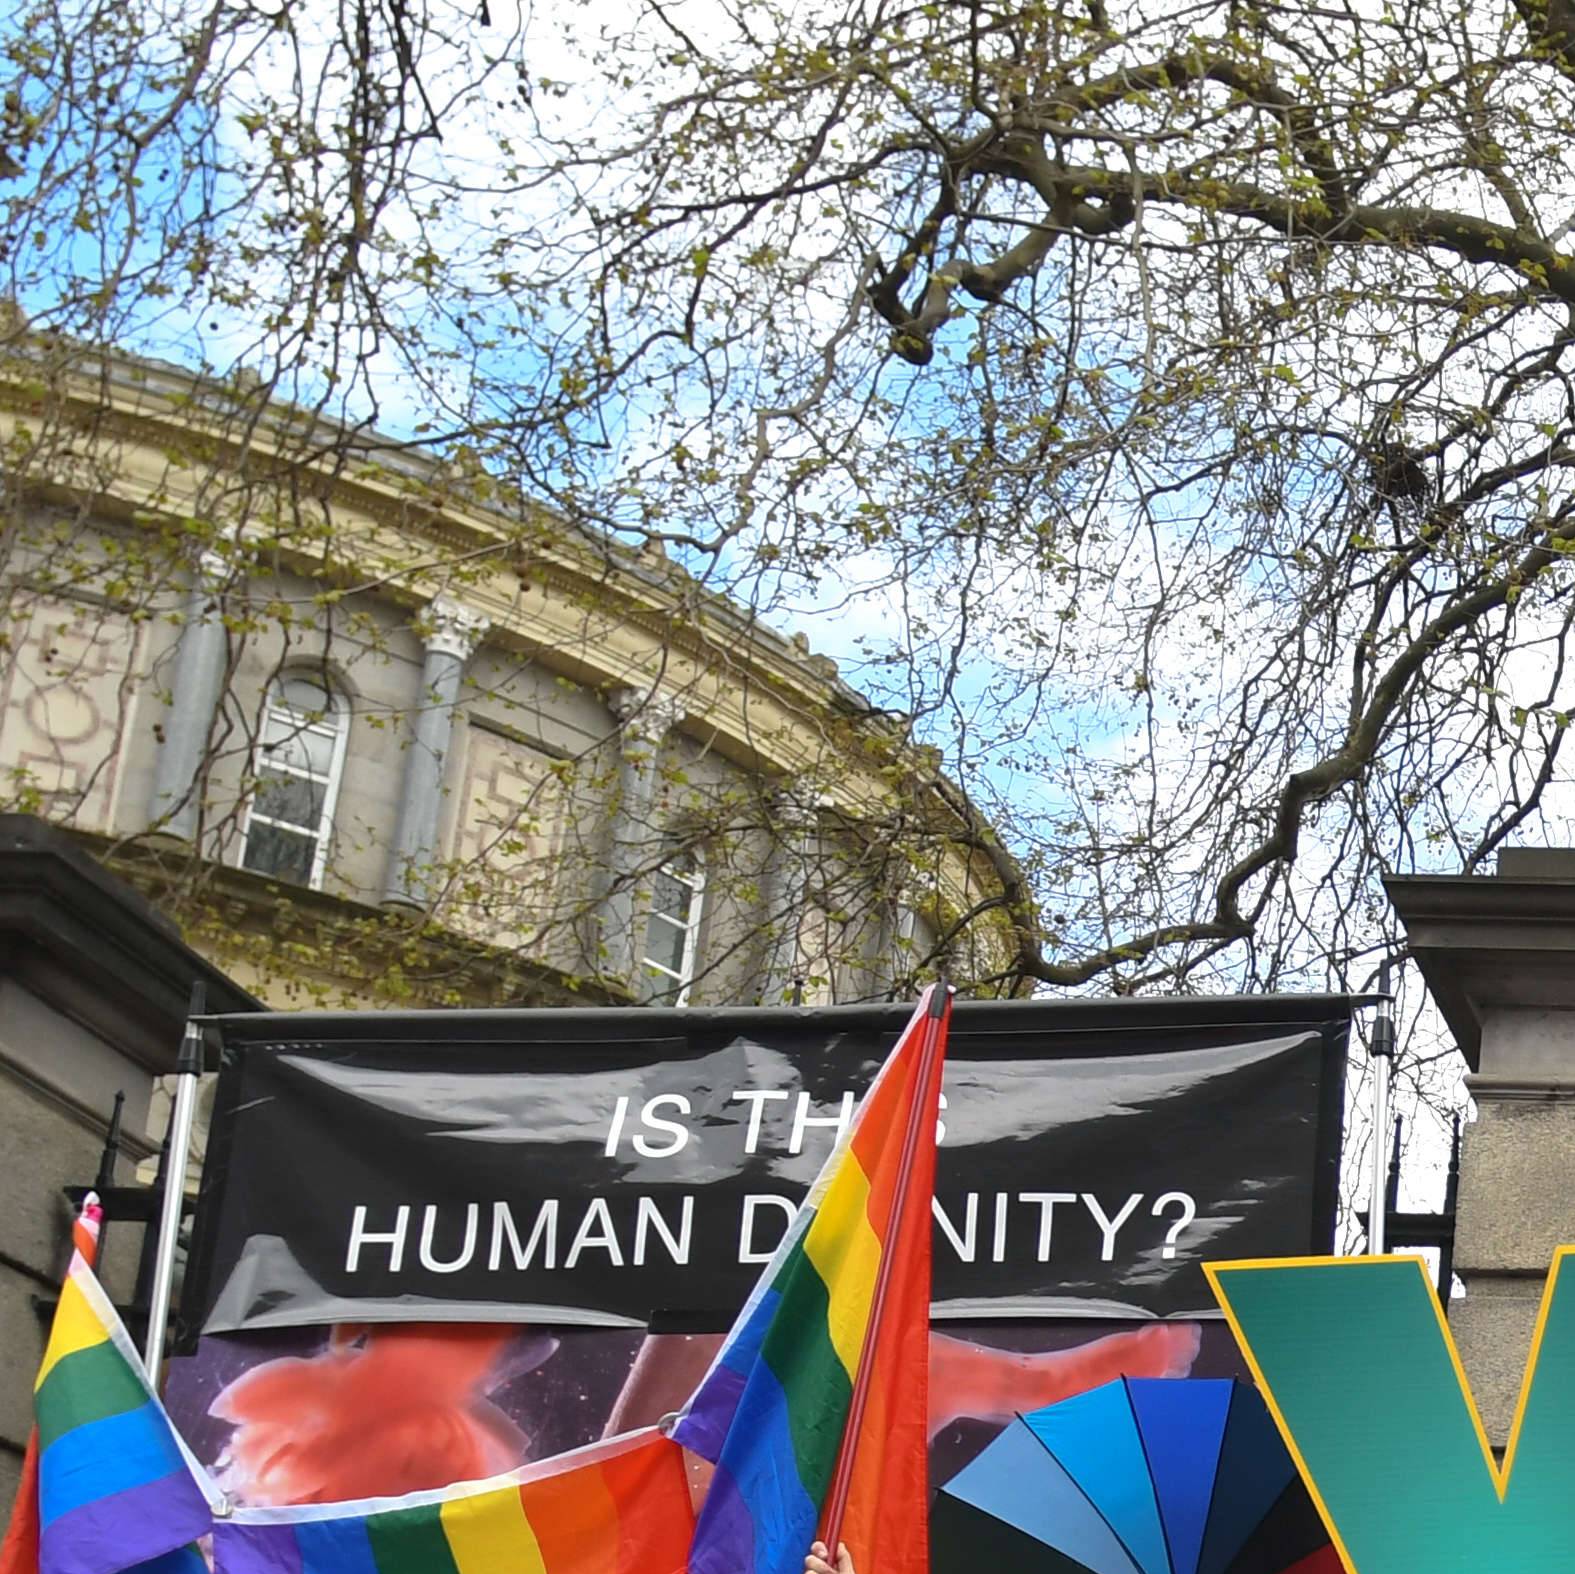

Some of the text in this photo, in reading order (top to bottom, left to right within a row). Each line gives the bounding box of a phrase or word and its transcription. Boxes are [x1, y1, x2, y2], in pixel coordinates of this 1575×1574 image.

[603, 1090, 948, 1158] IS TH
[345, 1192, 1196, 1273] HUMAN DNITY?
